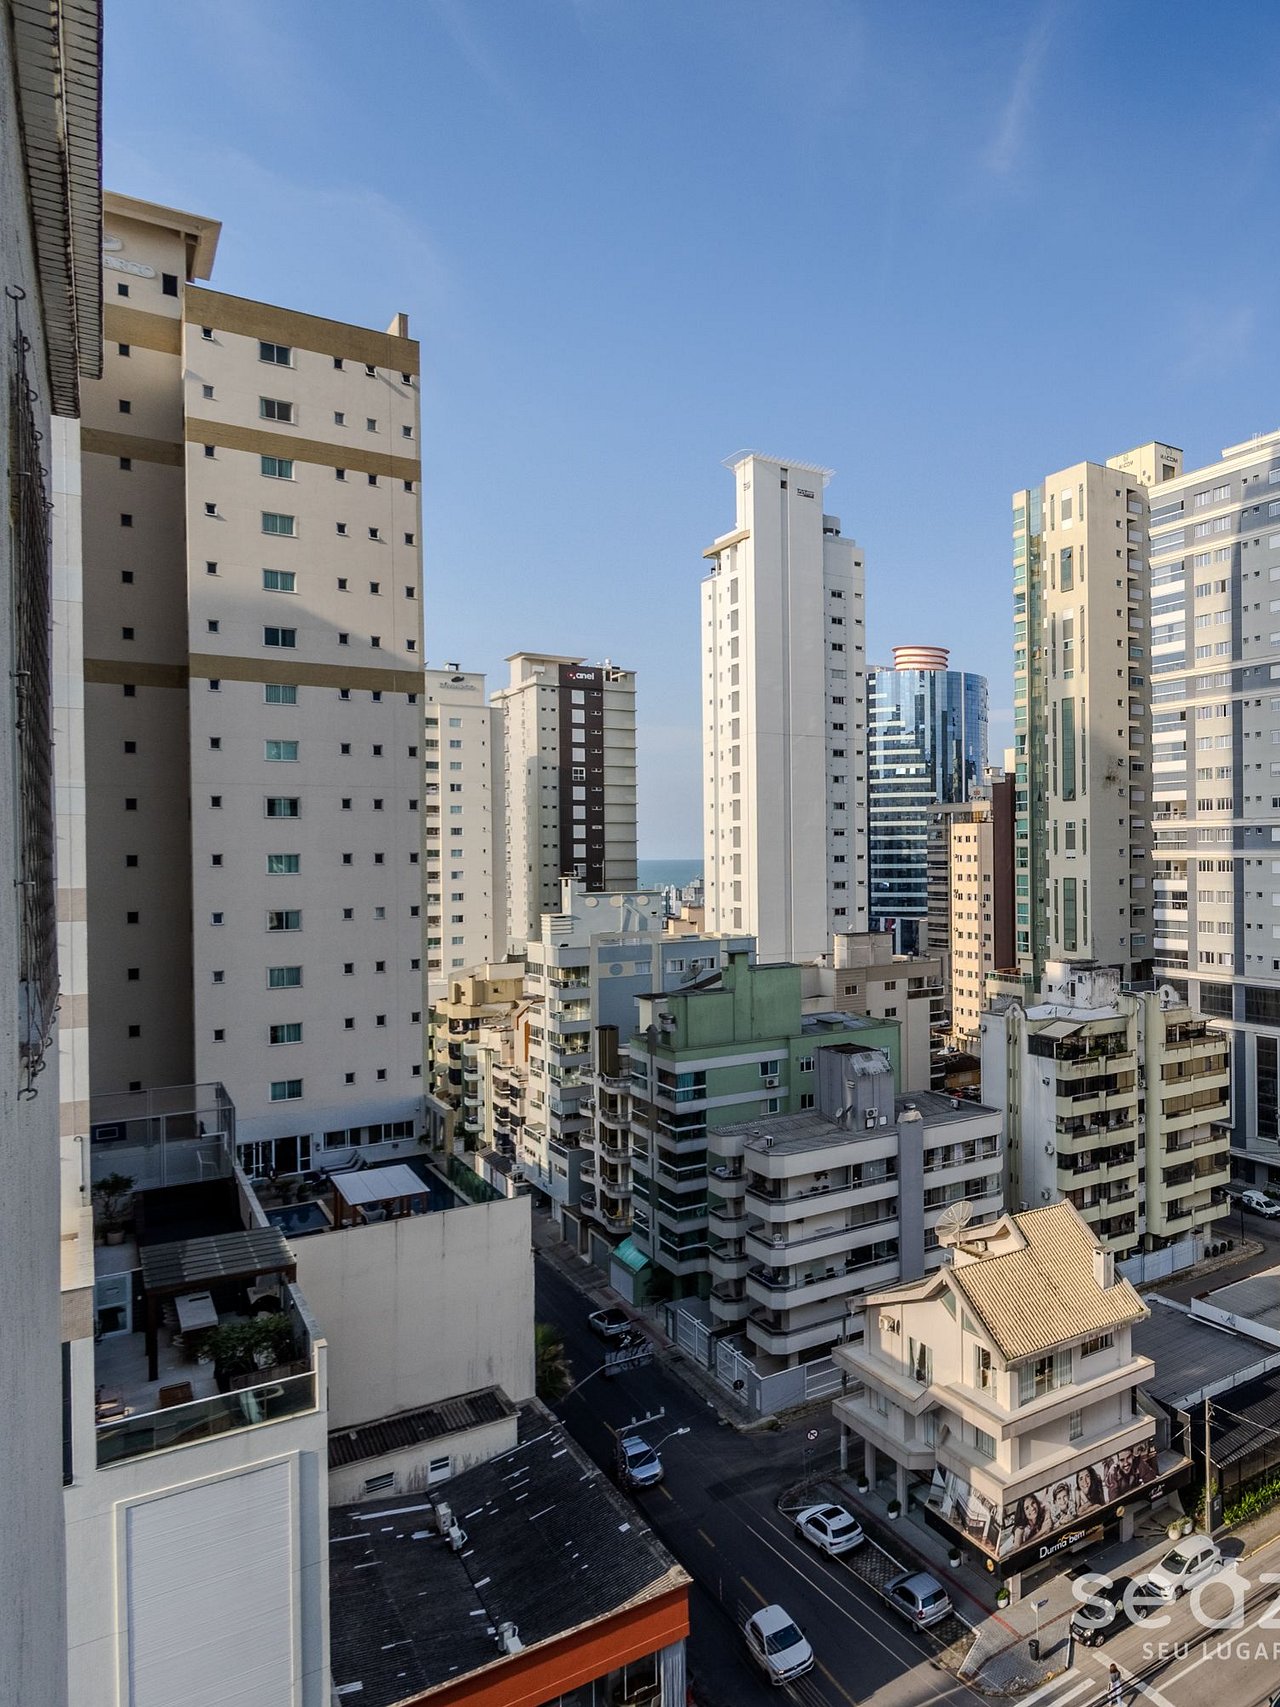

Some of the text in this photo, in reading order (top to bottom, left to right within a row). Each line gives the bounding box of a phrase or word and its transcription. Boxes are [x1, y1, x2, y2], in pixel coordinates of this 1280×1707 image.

[576, 672, 594, 681] anel
[1039, 1540, 1067, 1559] Durma
[1069, 1529, 1086, 1544] bem
